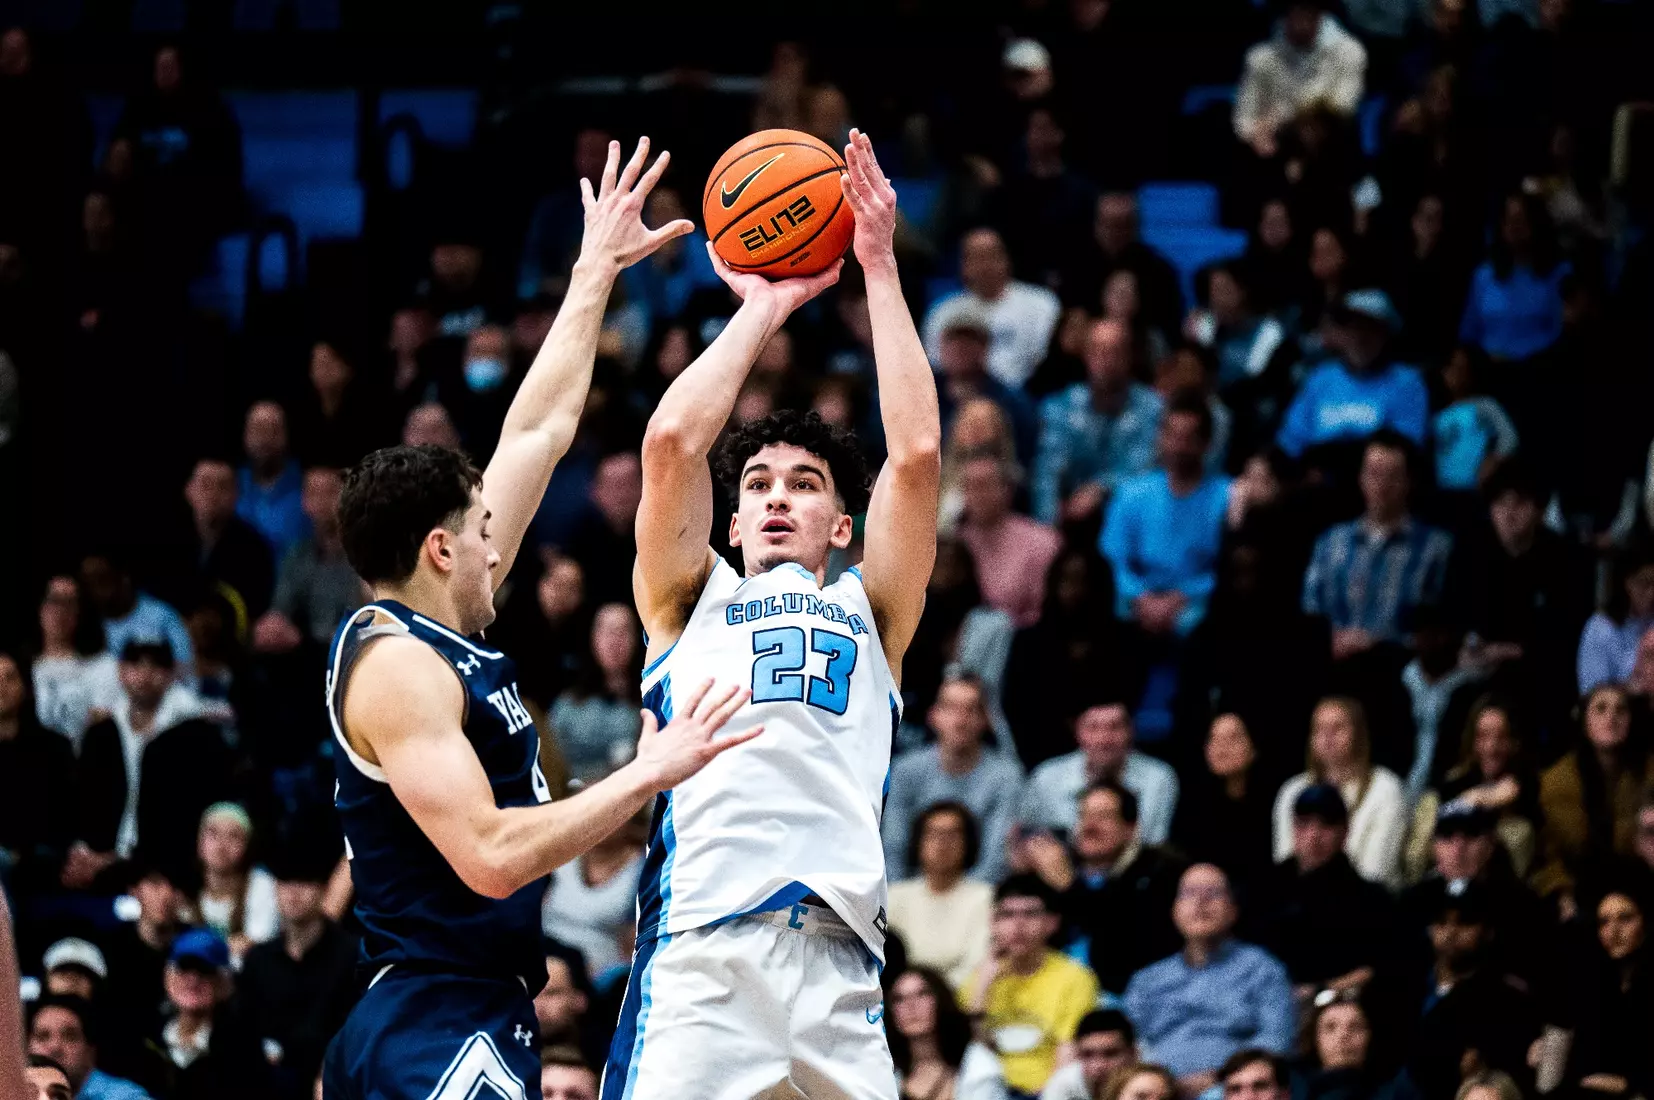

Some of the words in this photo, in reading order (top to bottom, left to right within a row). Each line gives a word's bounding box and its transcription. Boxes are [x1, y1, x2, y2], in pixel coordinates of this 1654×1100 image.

[738, 195, 816, 252] ELITE
[751, 626, 858, 716] 23
[788, 904, 809, 930] C
